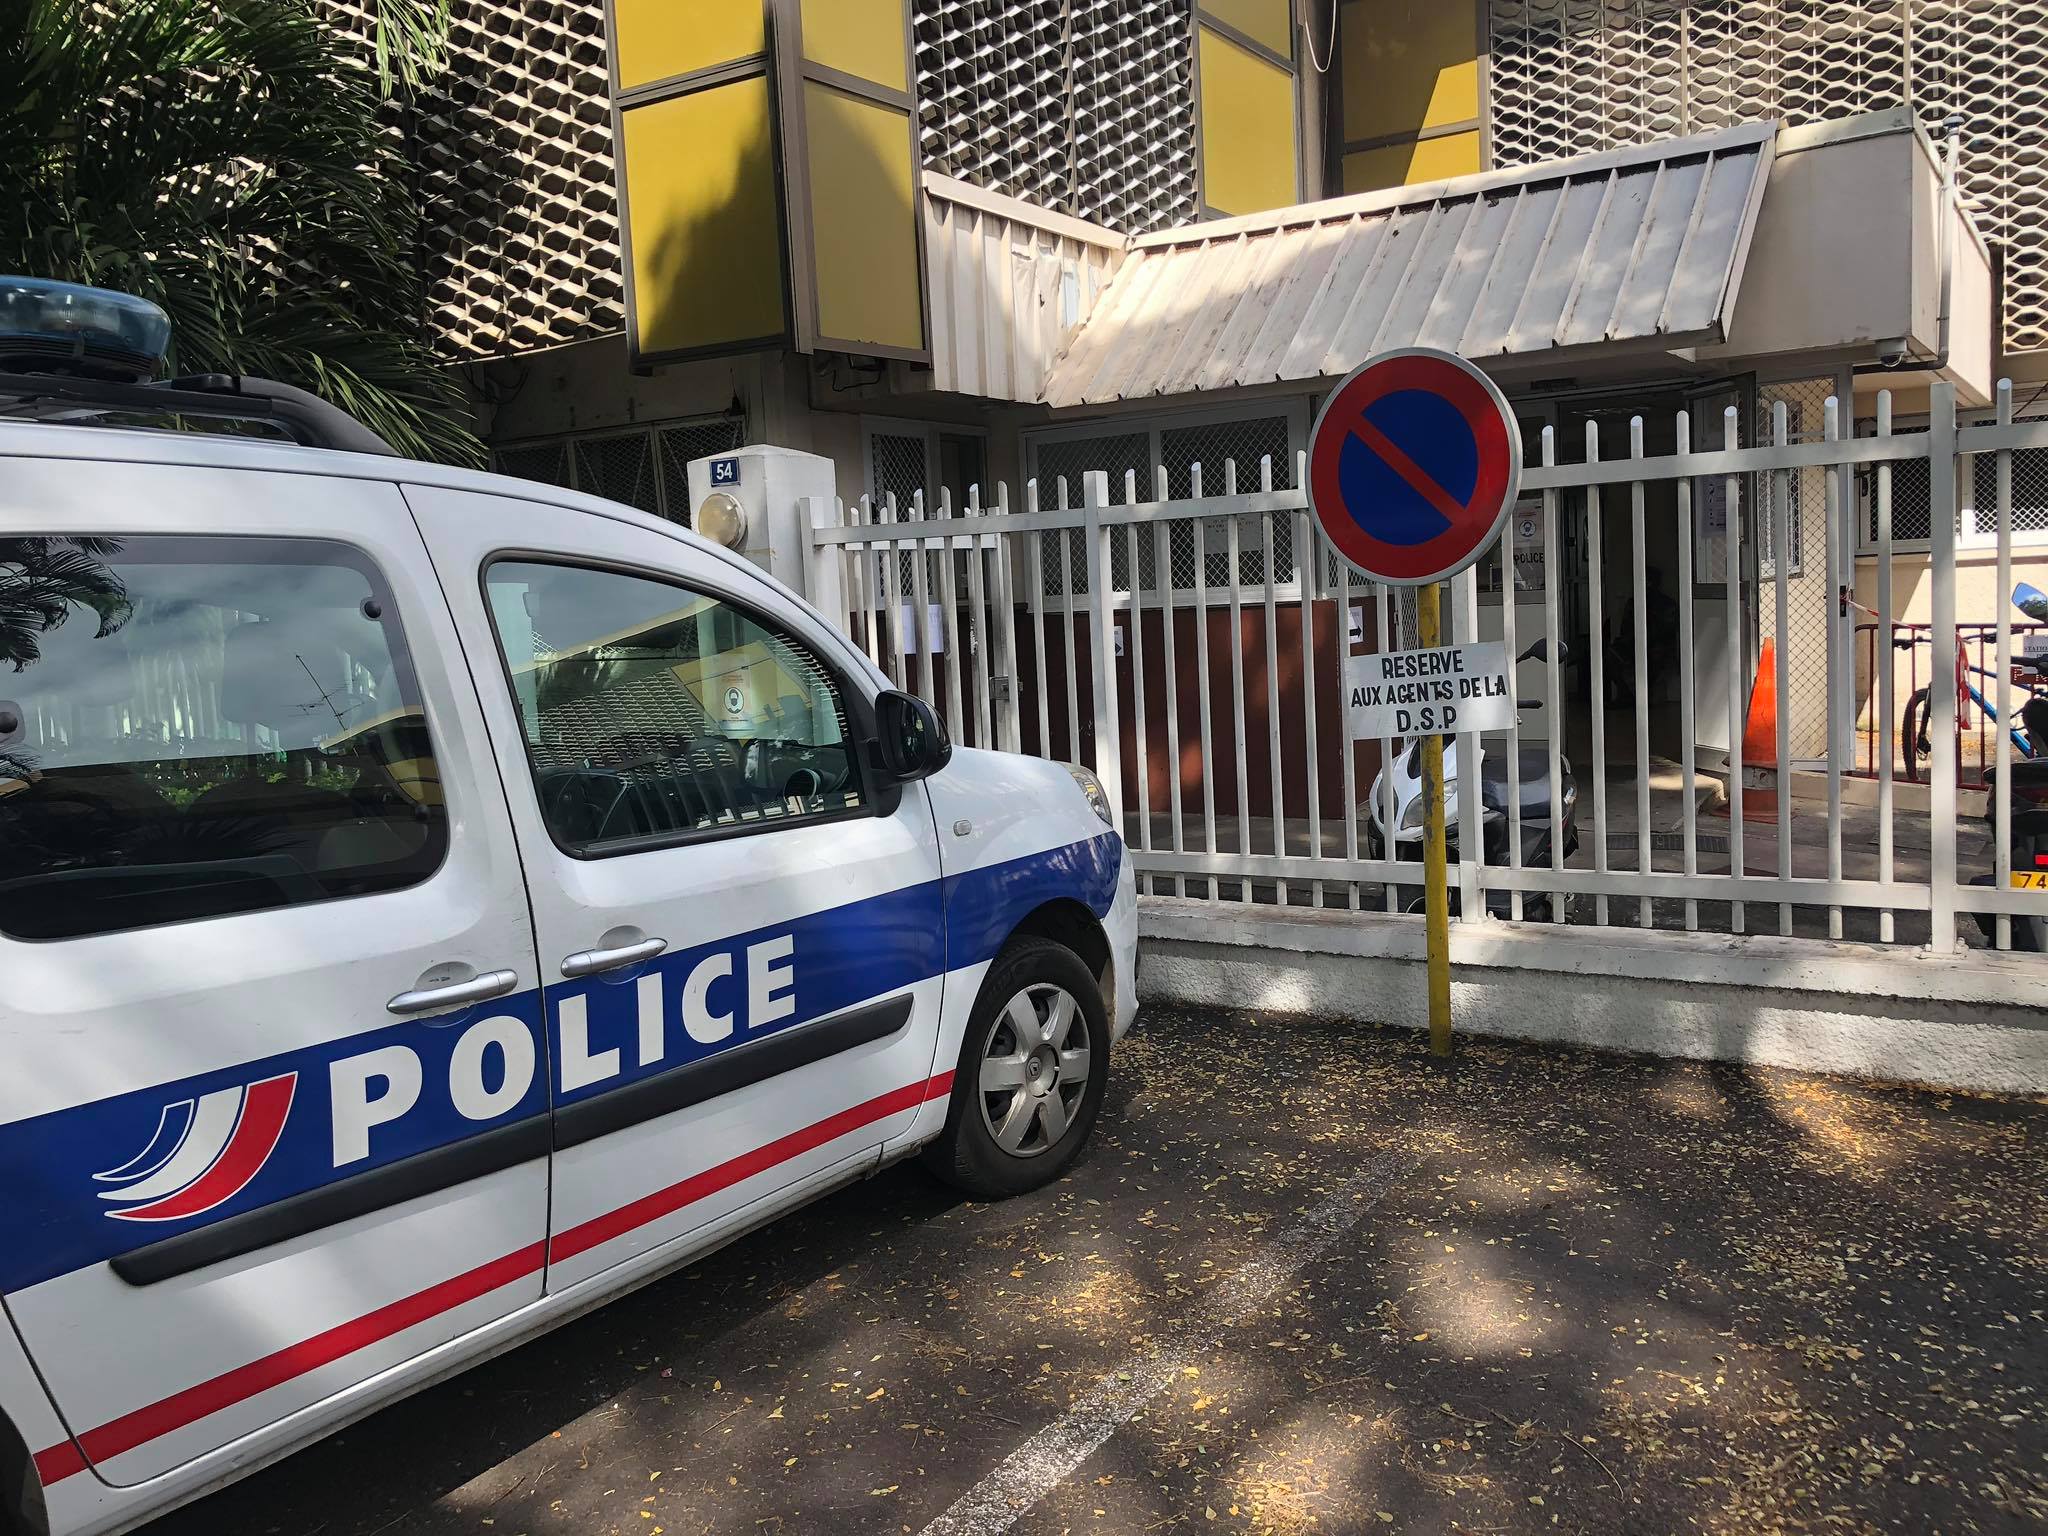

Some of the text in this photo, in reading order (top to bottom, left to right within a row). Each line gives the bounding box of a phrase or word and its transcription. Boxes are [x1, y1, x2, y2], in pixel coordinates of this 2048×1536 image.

[716, 462, 733, 480] 54
[1513, 552, 1544, 565] POLICE
[1381, 649, 1464, 679] RESERVE
[1351, 685, 1382, 708] AUX
[1386, 680, 1454, 705] AGENTS
[1396, 705, 1457, 733] D.S.P
[329, 933, 796, 1168] POLICE
